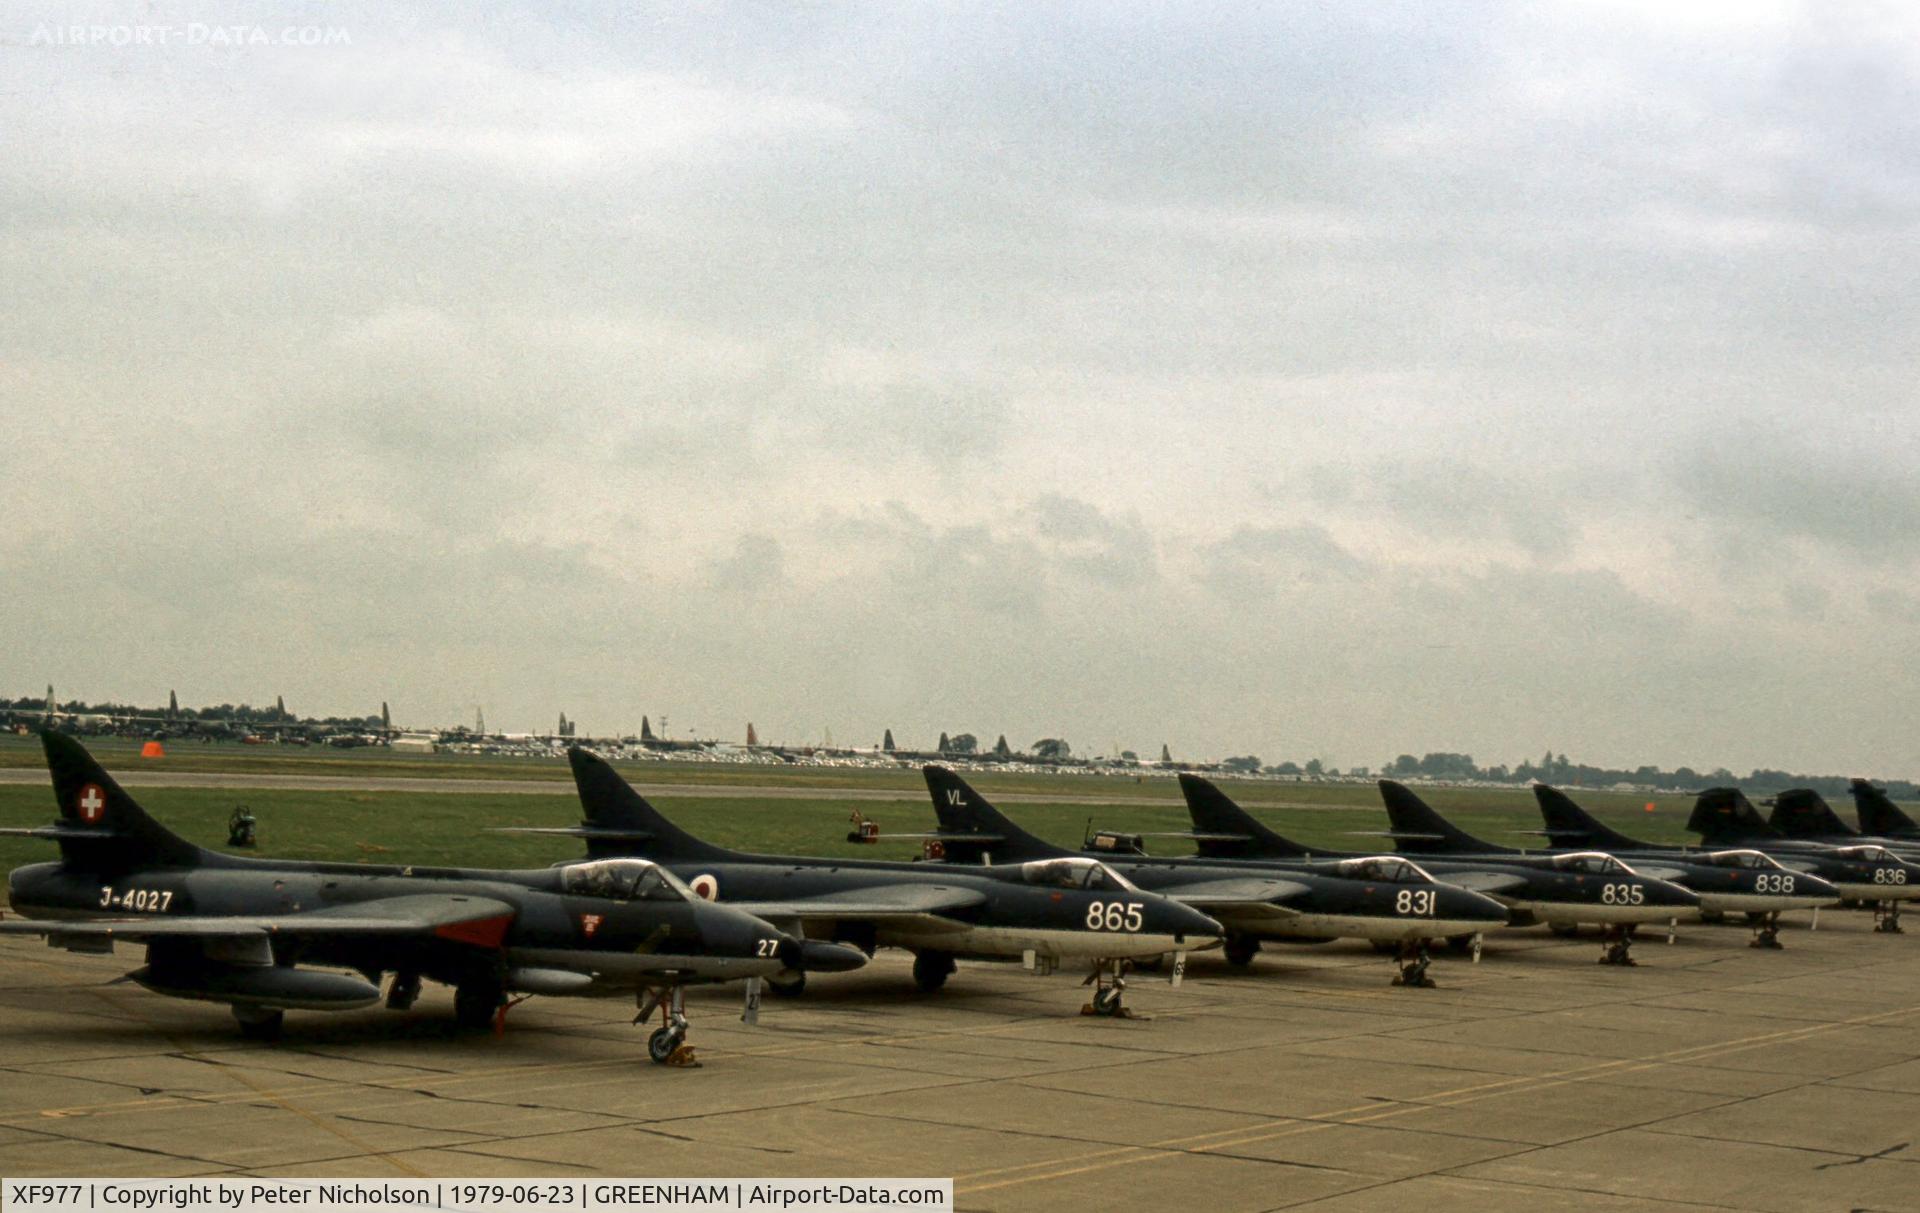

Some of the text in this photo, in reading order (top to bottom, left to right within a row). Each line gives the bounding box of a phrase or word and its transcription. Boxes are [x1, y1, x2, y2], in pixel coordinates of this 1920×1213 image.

[947, 789, 967, 806] VL
[1755, 874, 1795, 893] 838
[1874, 868, 1906, 884] 836
[100, 886, 173, 911] J-4027
[1396, 889, 1436, 915] 831
[1602, 883, 1645, 905] 835
[1086, 901, 1144, 931] 865
[758, 939, 778, 957] 27
